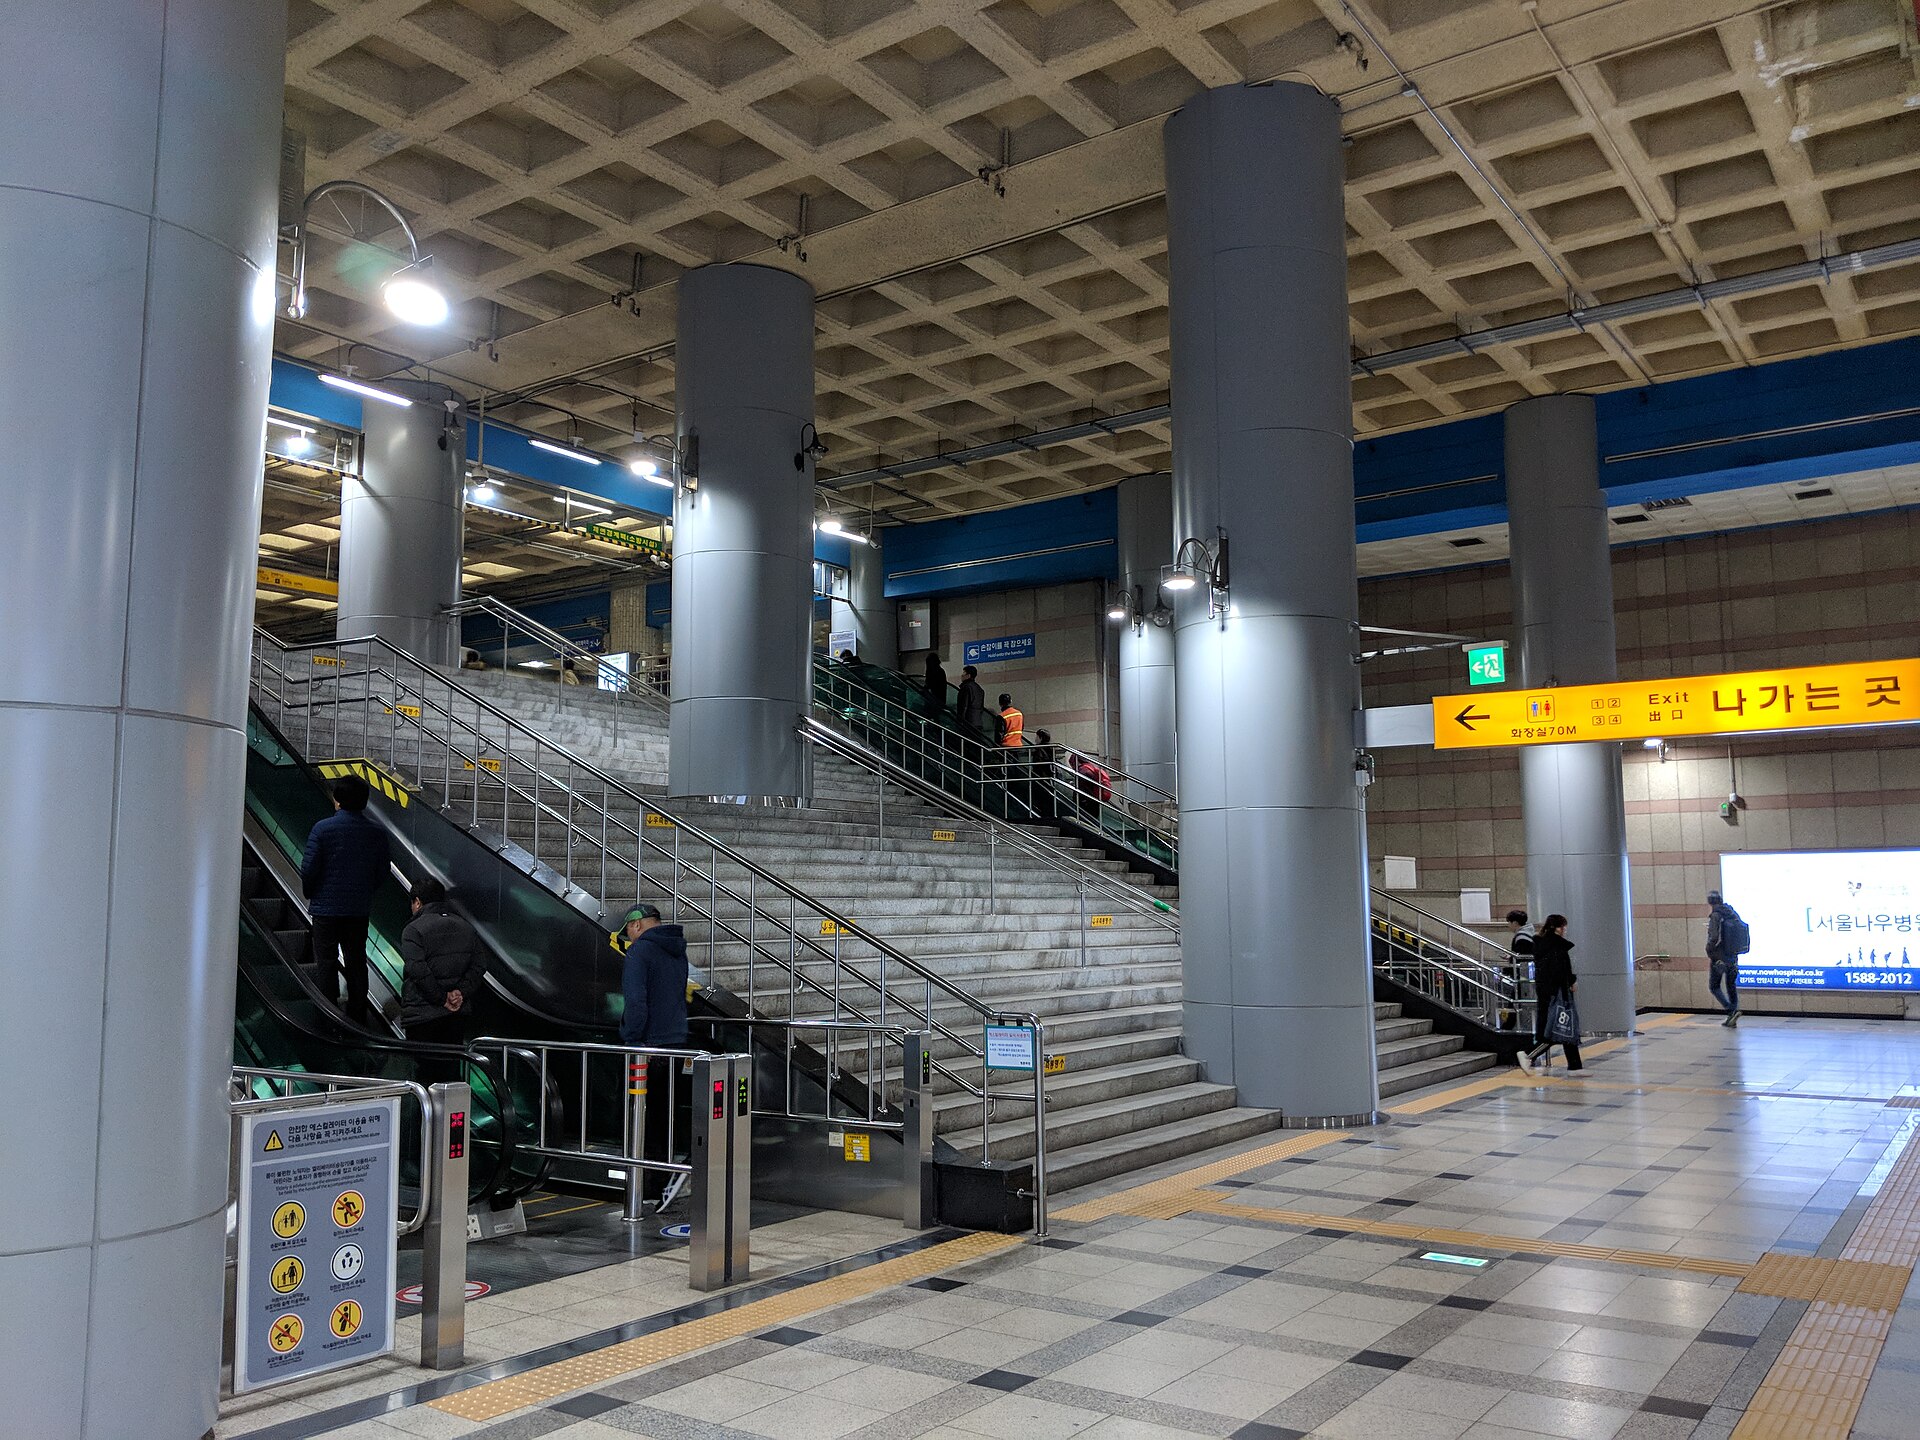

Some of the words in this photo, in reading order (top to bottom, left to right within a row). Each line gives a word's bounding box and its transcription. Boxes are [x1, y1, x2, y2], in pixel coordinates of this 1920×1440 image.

[1649, 692, 1689, 704] Exit
[1712, 683, 1840, 717] 나가는
[1865, 676, 1902, 707] 곳
[1739, 969, 1824, 977] www.nowhospital.co.kr
[1844, 972, 1912, 985] 1588-2012
[310, 1120, 346, 1131] 에스컬레이터
[349, 1117, 366, 1125] 이용을
[369, 1115, 380, 1123] 위해
[288, 1135, 300, 1143] 다음
[333, 1127, 362, 1136] 지켜주세요
